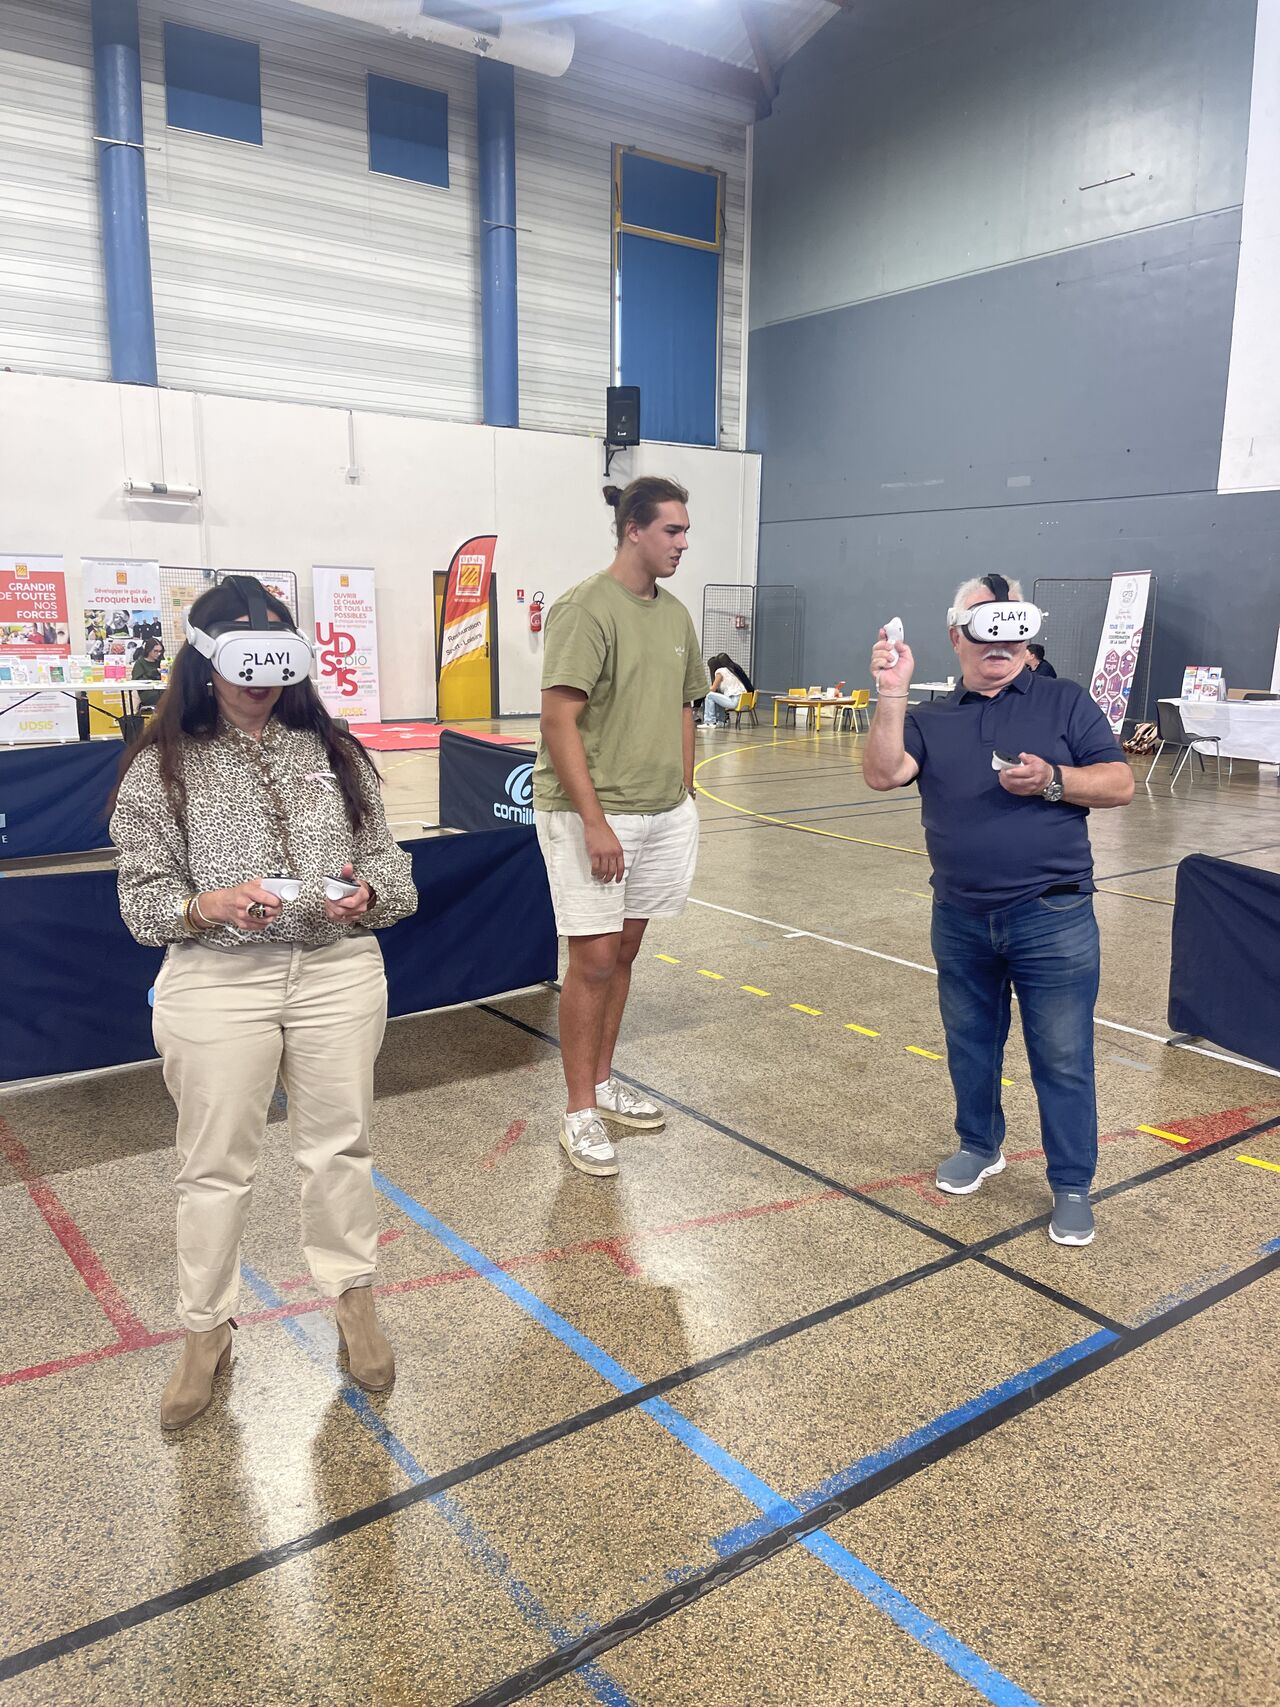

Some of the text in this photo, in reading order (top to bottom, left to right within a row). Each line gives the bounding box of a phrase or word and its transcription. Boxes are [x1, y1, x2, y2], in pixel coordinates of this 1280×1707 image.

[8, 582, 56, 592] GRANDIR
[0, 591, 57, 601] DE TOUTES
[95, 596, 130, 605] croquer
[131, 595, 139, 604] la
[33, 601, 58, 610] NOS
[16, 610, 59, 619] FORCES
[992, 610, 1027, 622] PLAY!
[243, 652, 290, 666] PLAY!
[18, 720, 54, 731] UDSIS
